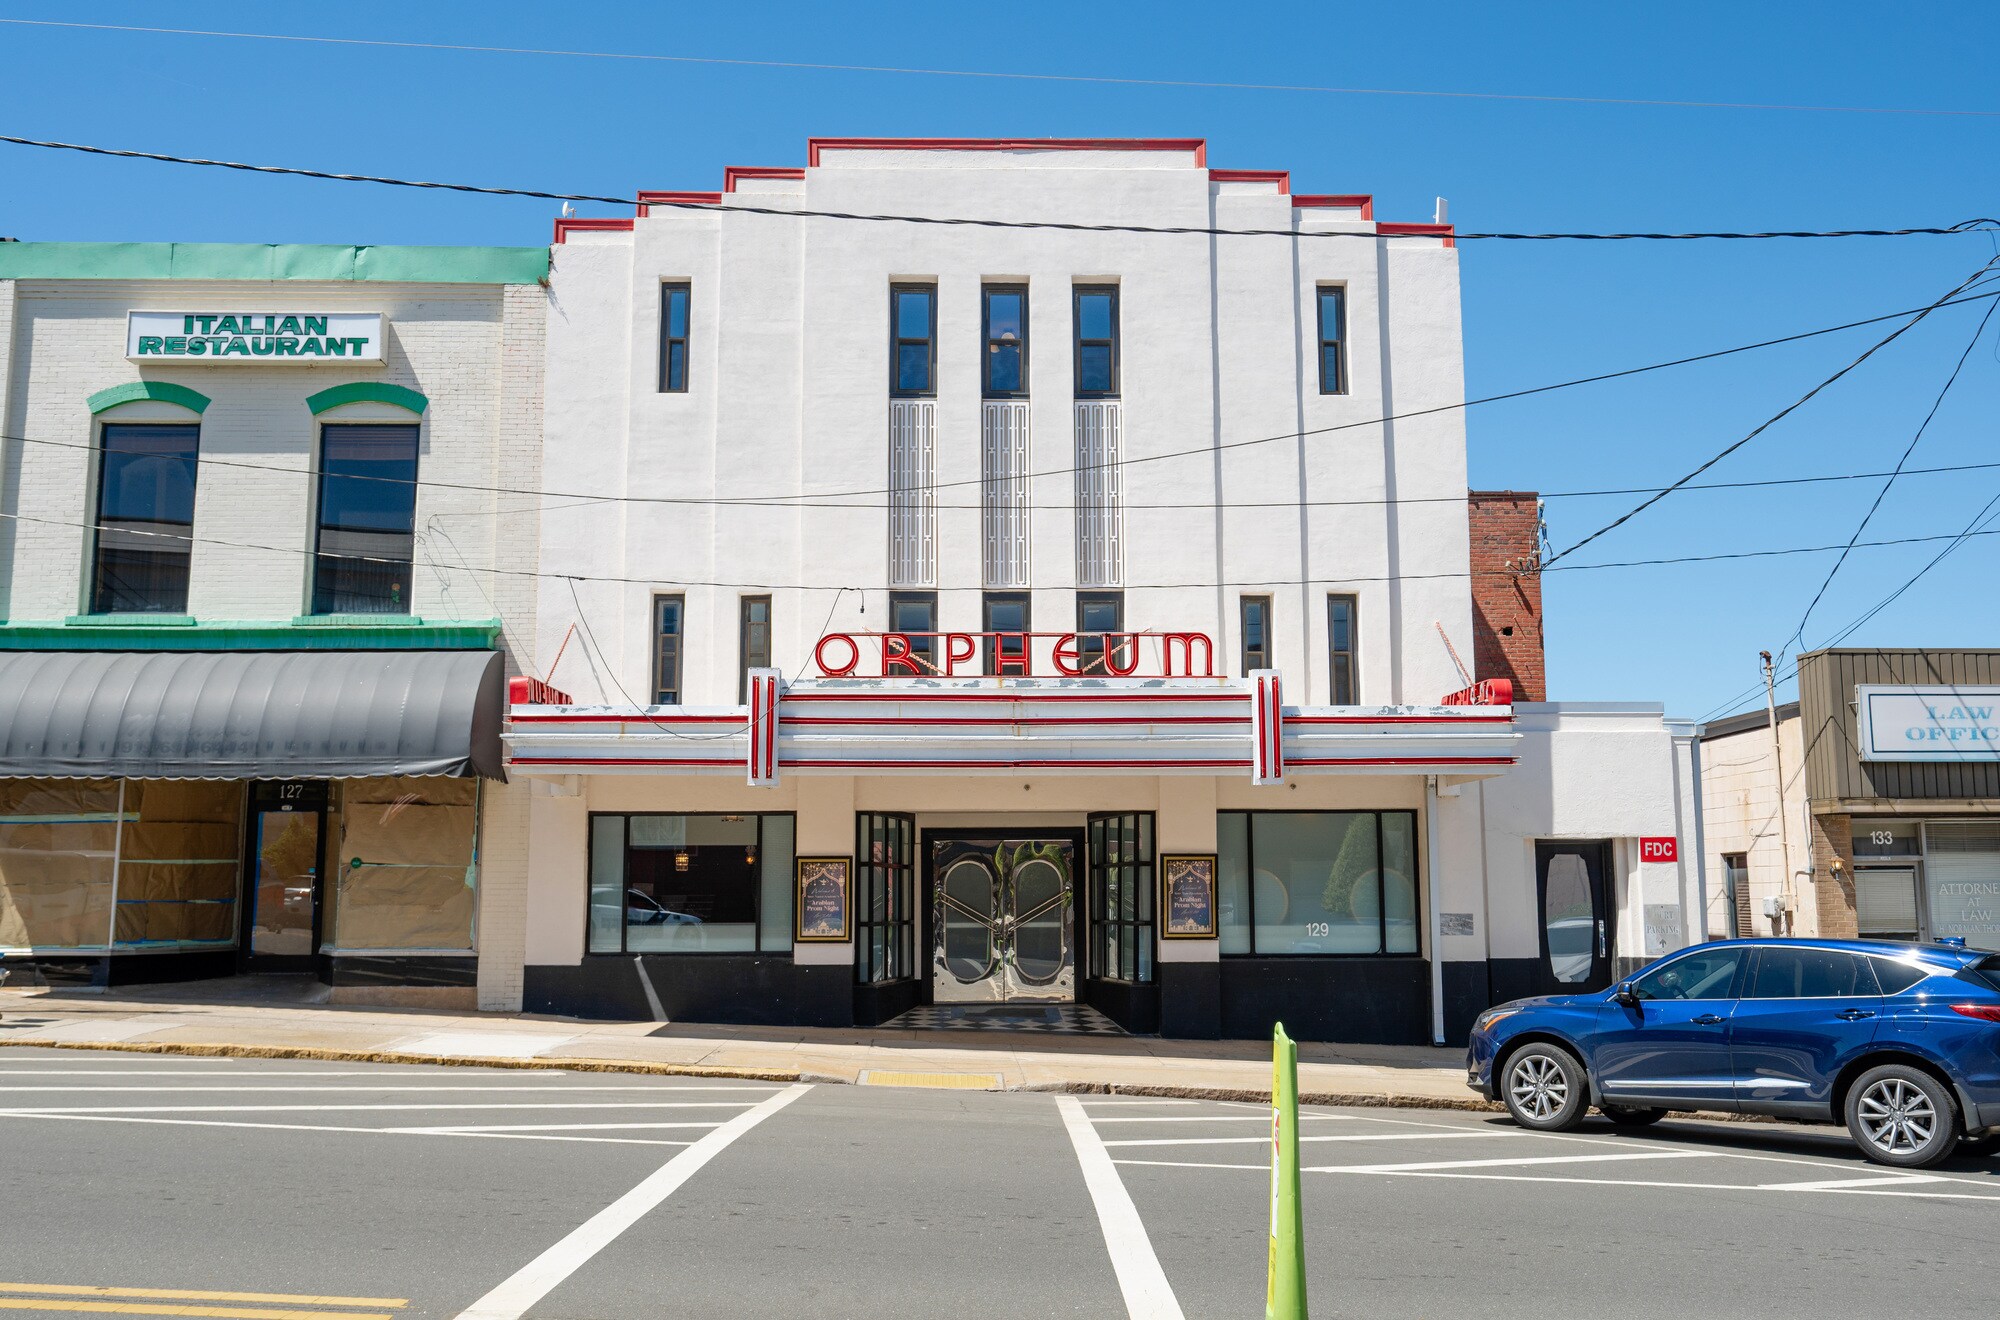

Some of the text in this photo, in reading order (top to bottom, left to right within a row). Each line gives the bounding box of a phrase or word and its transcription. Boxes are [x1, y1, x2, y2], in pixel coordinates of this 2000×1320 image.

[183, 315, 328, 335] ITALIAN
[138, 336, 369, 356] RESTAURANT
[815, 632, 1213, 676] ORPHEUM
[1926, 706, 1993, 719] LAW
[280, 785, 304, 799] 127
[1870, 831, 1893, 845] 133
[1644, 842, 1673, 856] FDC
[1939, 883, 2000, 895] ATTORNE
[1967, 897, 1980, 907] AT
[1961, 909, 1992, 921] LAW
[1306, 922, 1329, 937] 129
[1646, 925, 1679, 935] PARKING
